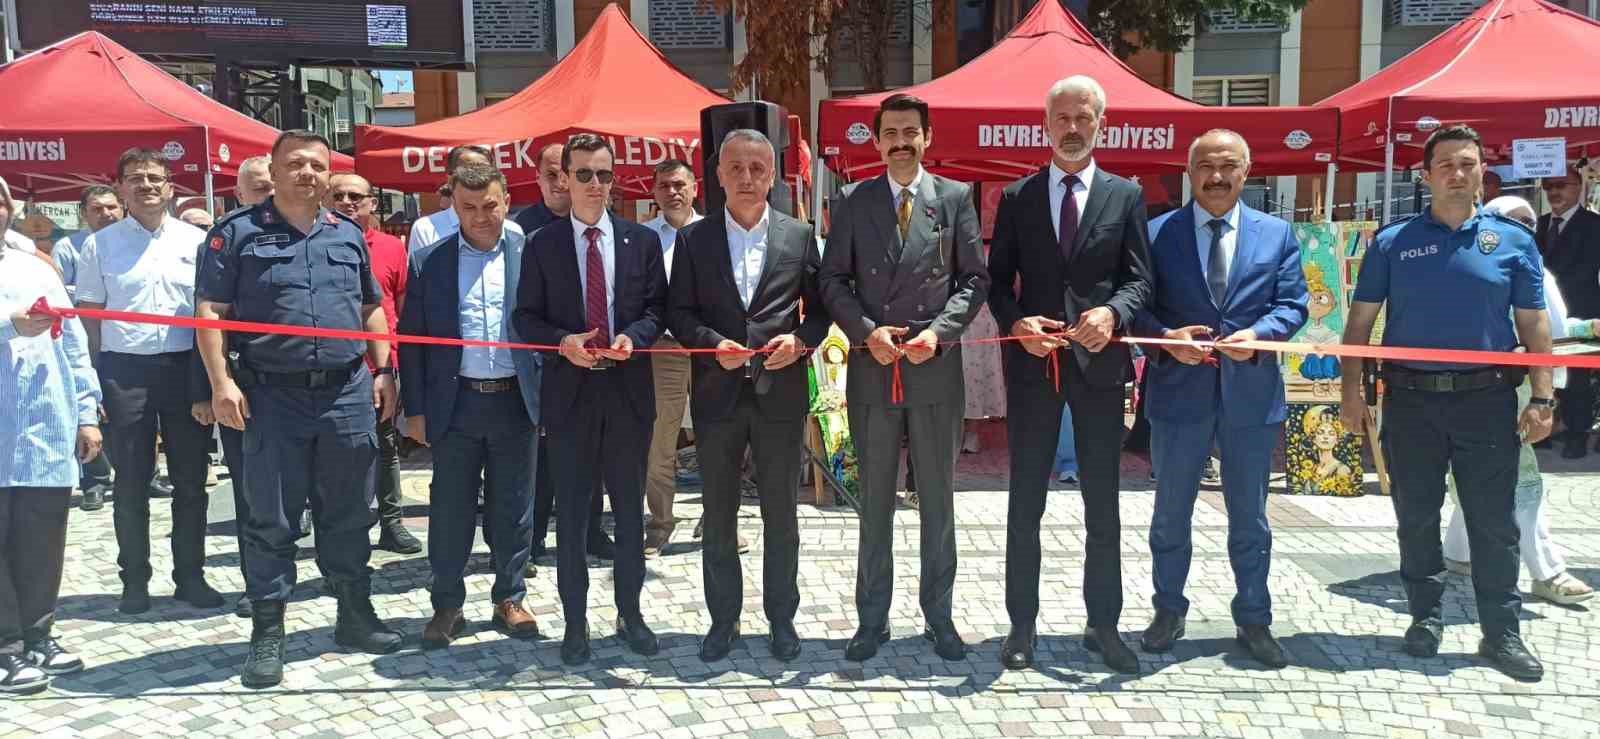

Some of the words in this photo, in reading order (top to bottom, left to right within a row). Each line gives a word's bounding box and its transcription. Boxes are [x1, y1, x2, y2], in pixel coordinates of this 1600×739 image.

[1544, 106, 1600, 128] DEVR
[0, 137, 66, 161] EDİYESİ
[1095, 122, 1175, 150] EDİYESİ
[402, 136, 536, 174] DEEK
